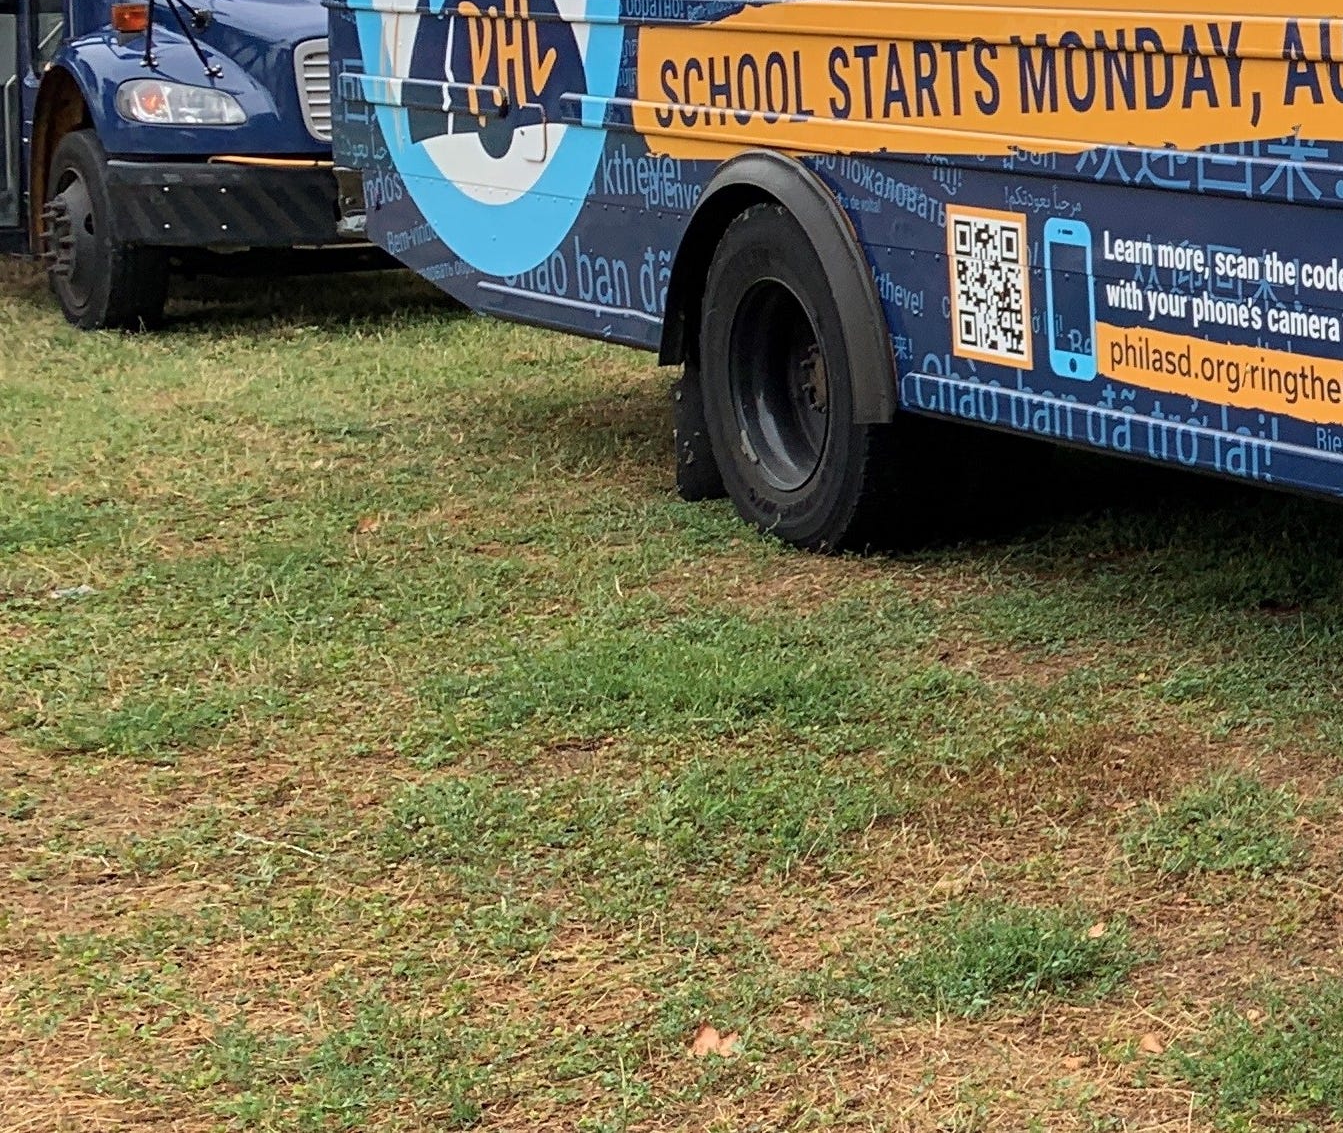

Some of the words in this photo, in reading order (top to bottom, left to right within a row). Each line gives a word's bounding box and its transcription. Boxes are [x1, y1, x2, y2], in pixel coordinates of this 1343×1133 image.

[655, 50, 815, 130] SCHOOL
[828, 39, 1000, 121] STARTS
[1016, 20, 1264, 127] MONDAY,
[1103, 231, 1153, 267] Learn
[1158, 242, 1209, 280] more,
[1215, 253, 1259, 281] scan
[1265, 253, 1297, 285] the
[1105, 281, 1143, 313] with
[1147, 288, 1188, 322] your
[1192, 294, 1262, 330] phone's
[1267, 307, 1341, 341] camera
